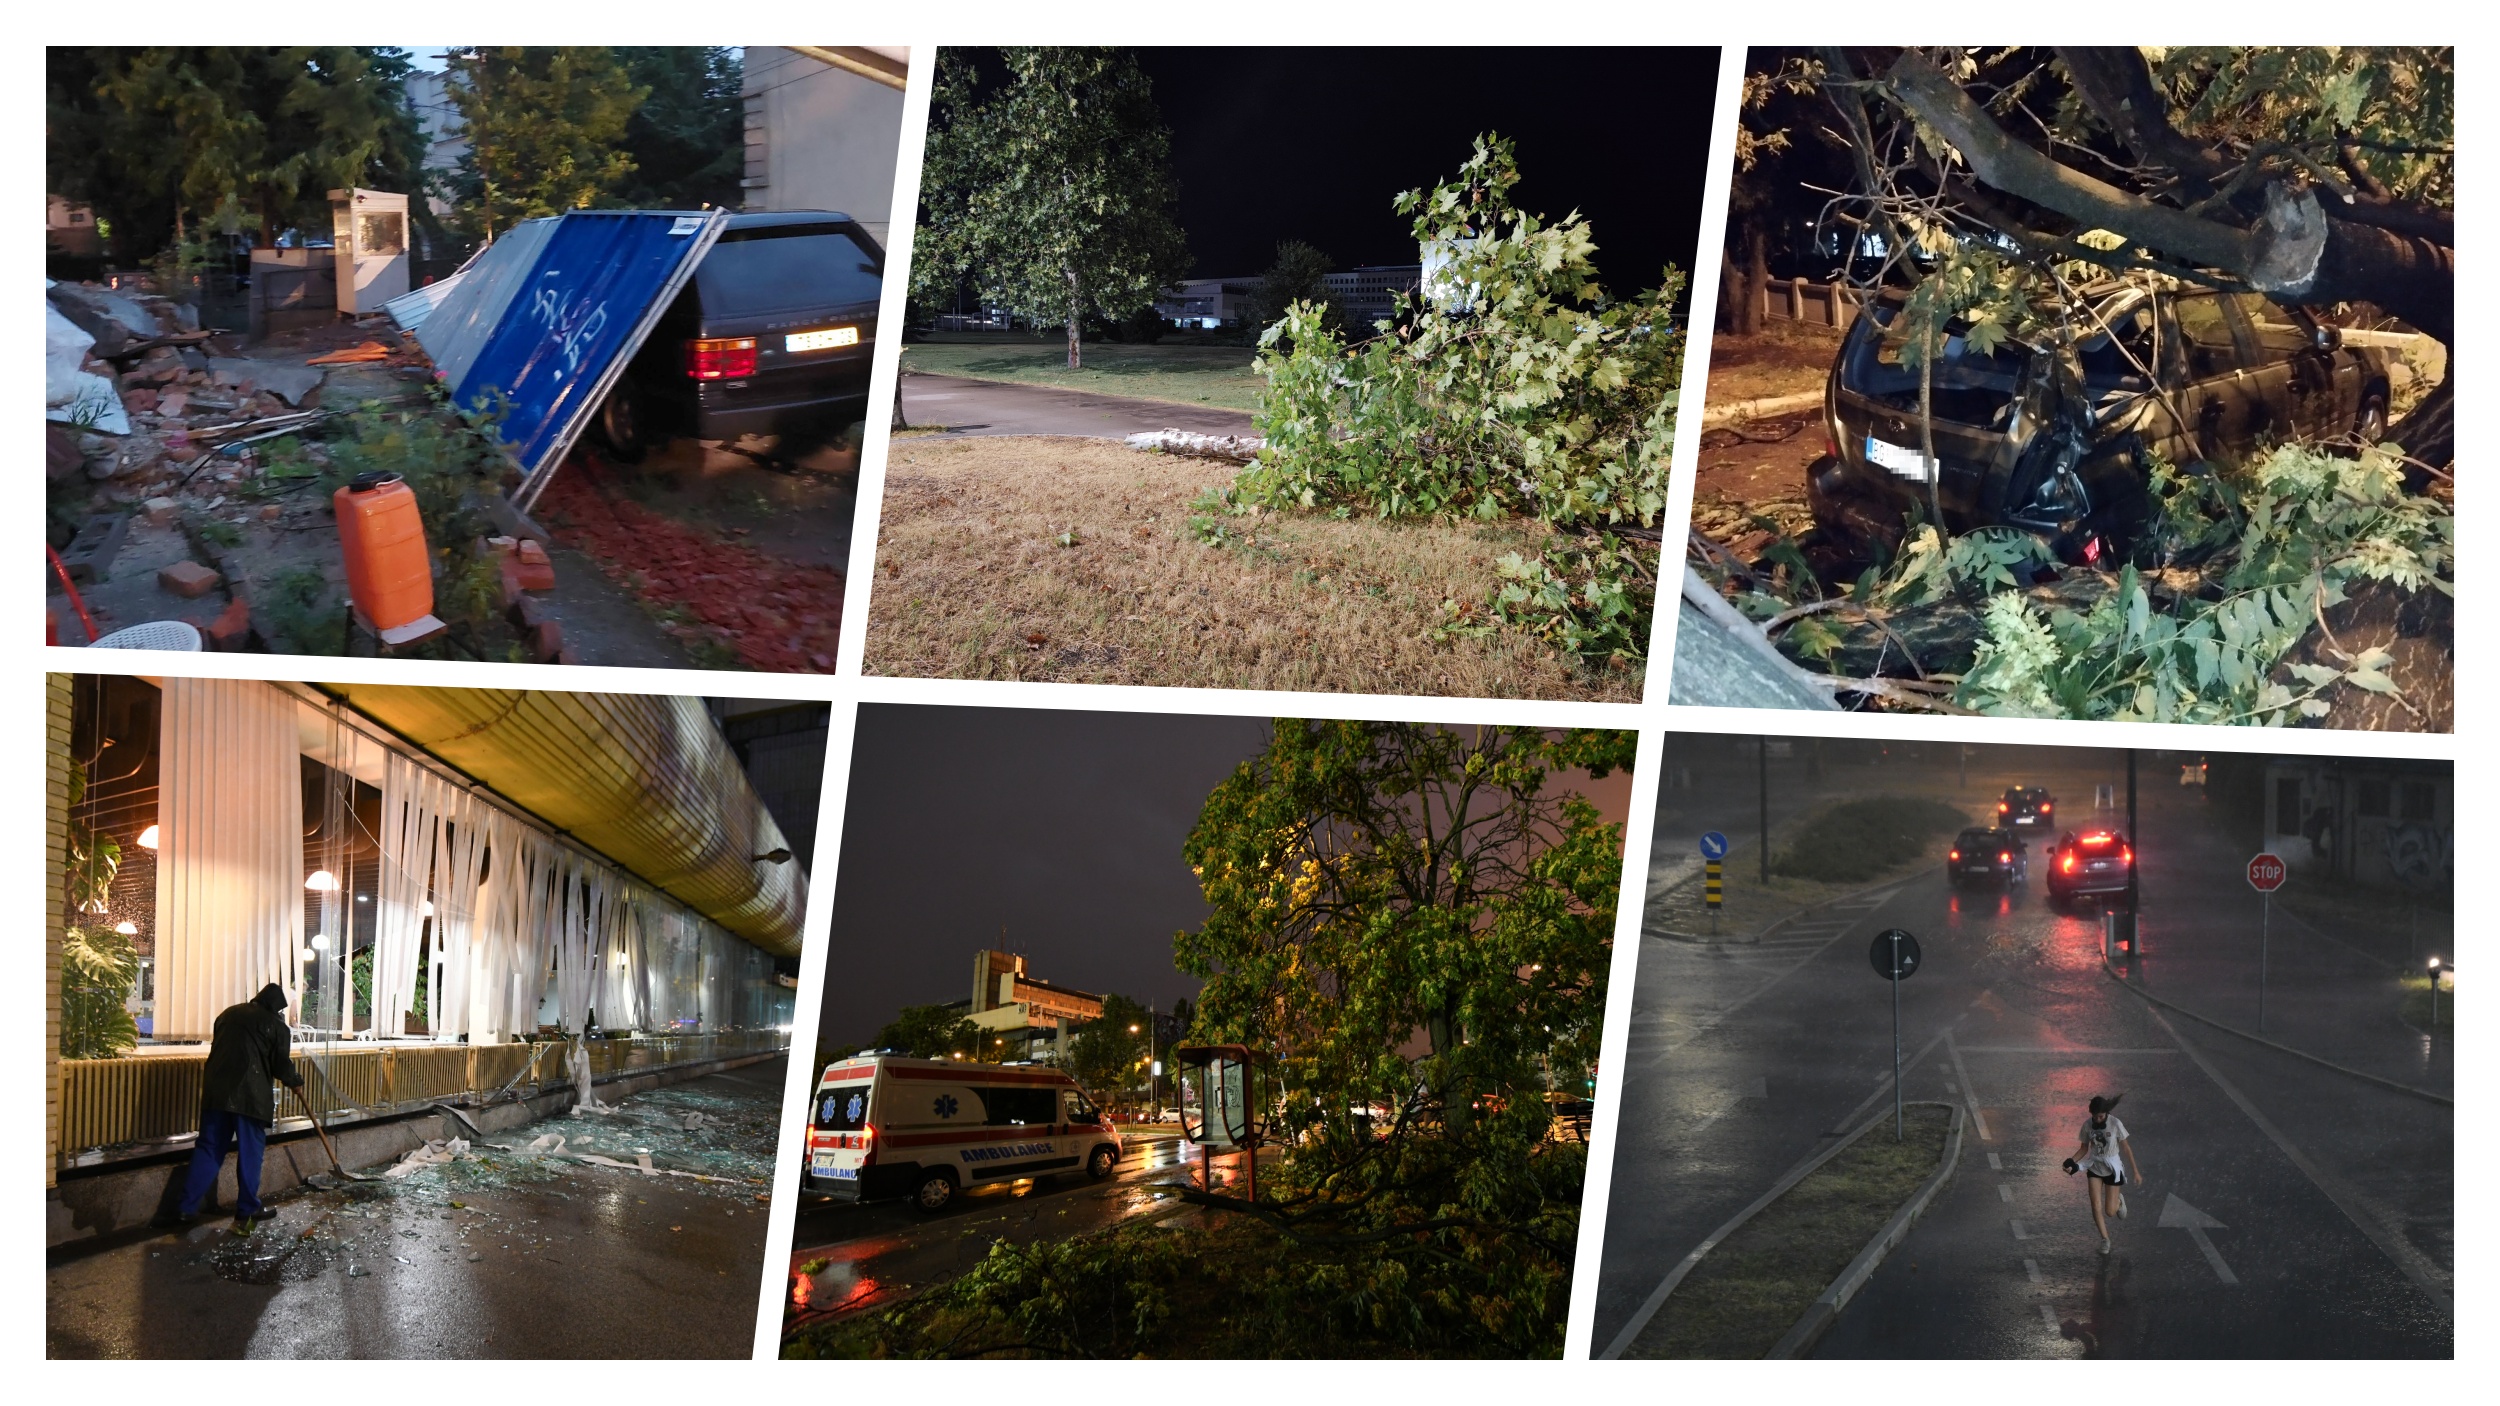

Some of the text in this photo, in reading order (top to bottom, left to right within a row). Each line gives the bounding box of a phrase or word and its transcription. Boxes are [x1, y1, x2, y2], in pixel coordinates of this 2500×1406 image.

[767, 317, 822, 330] RANGE
[2252, 865, 2282, 879] STOP
[960, 1142, 1055, 1163] AMBULANCE
[812, 1166, 857, 1179] AMBULANC
